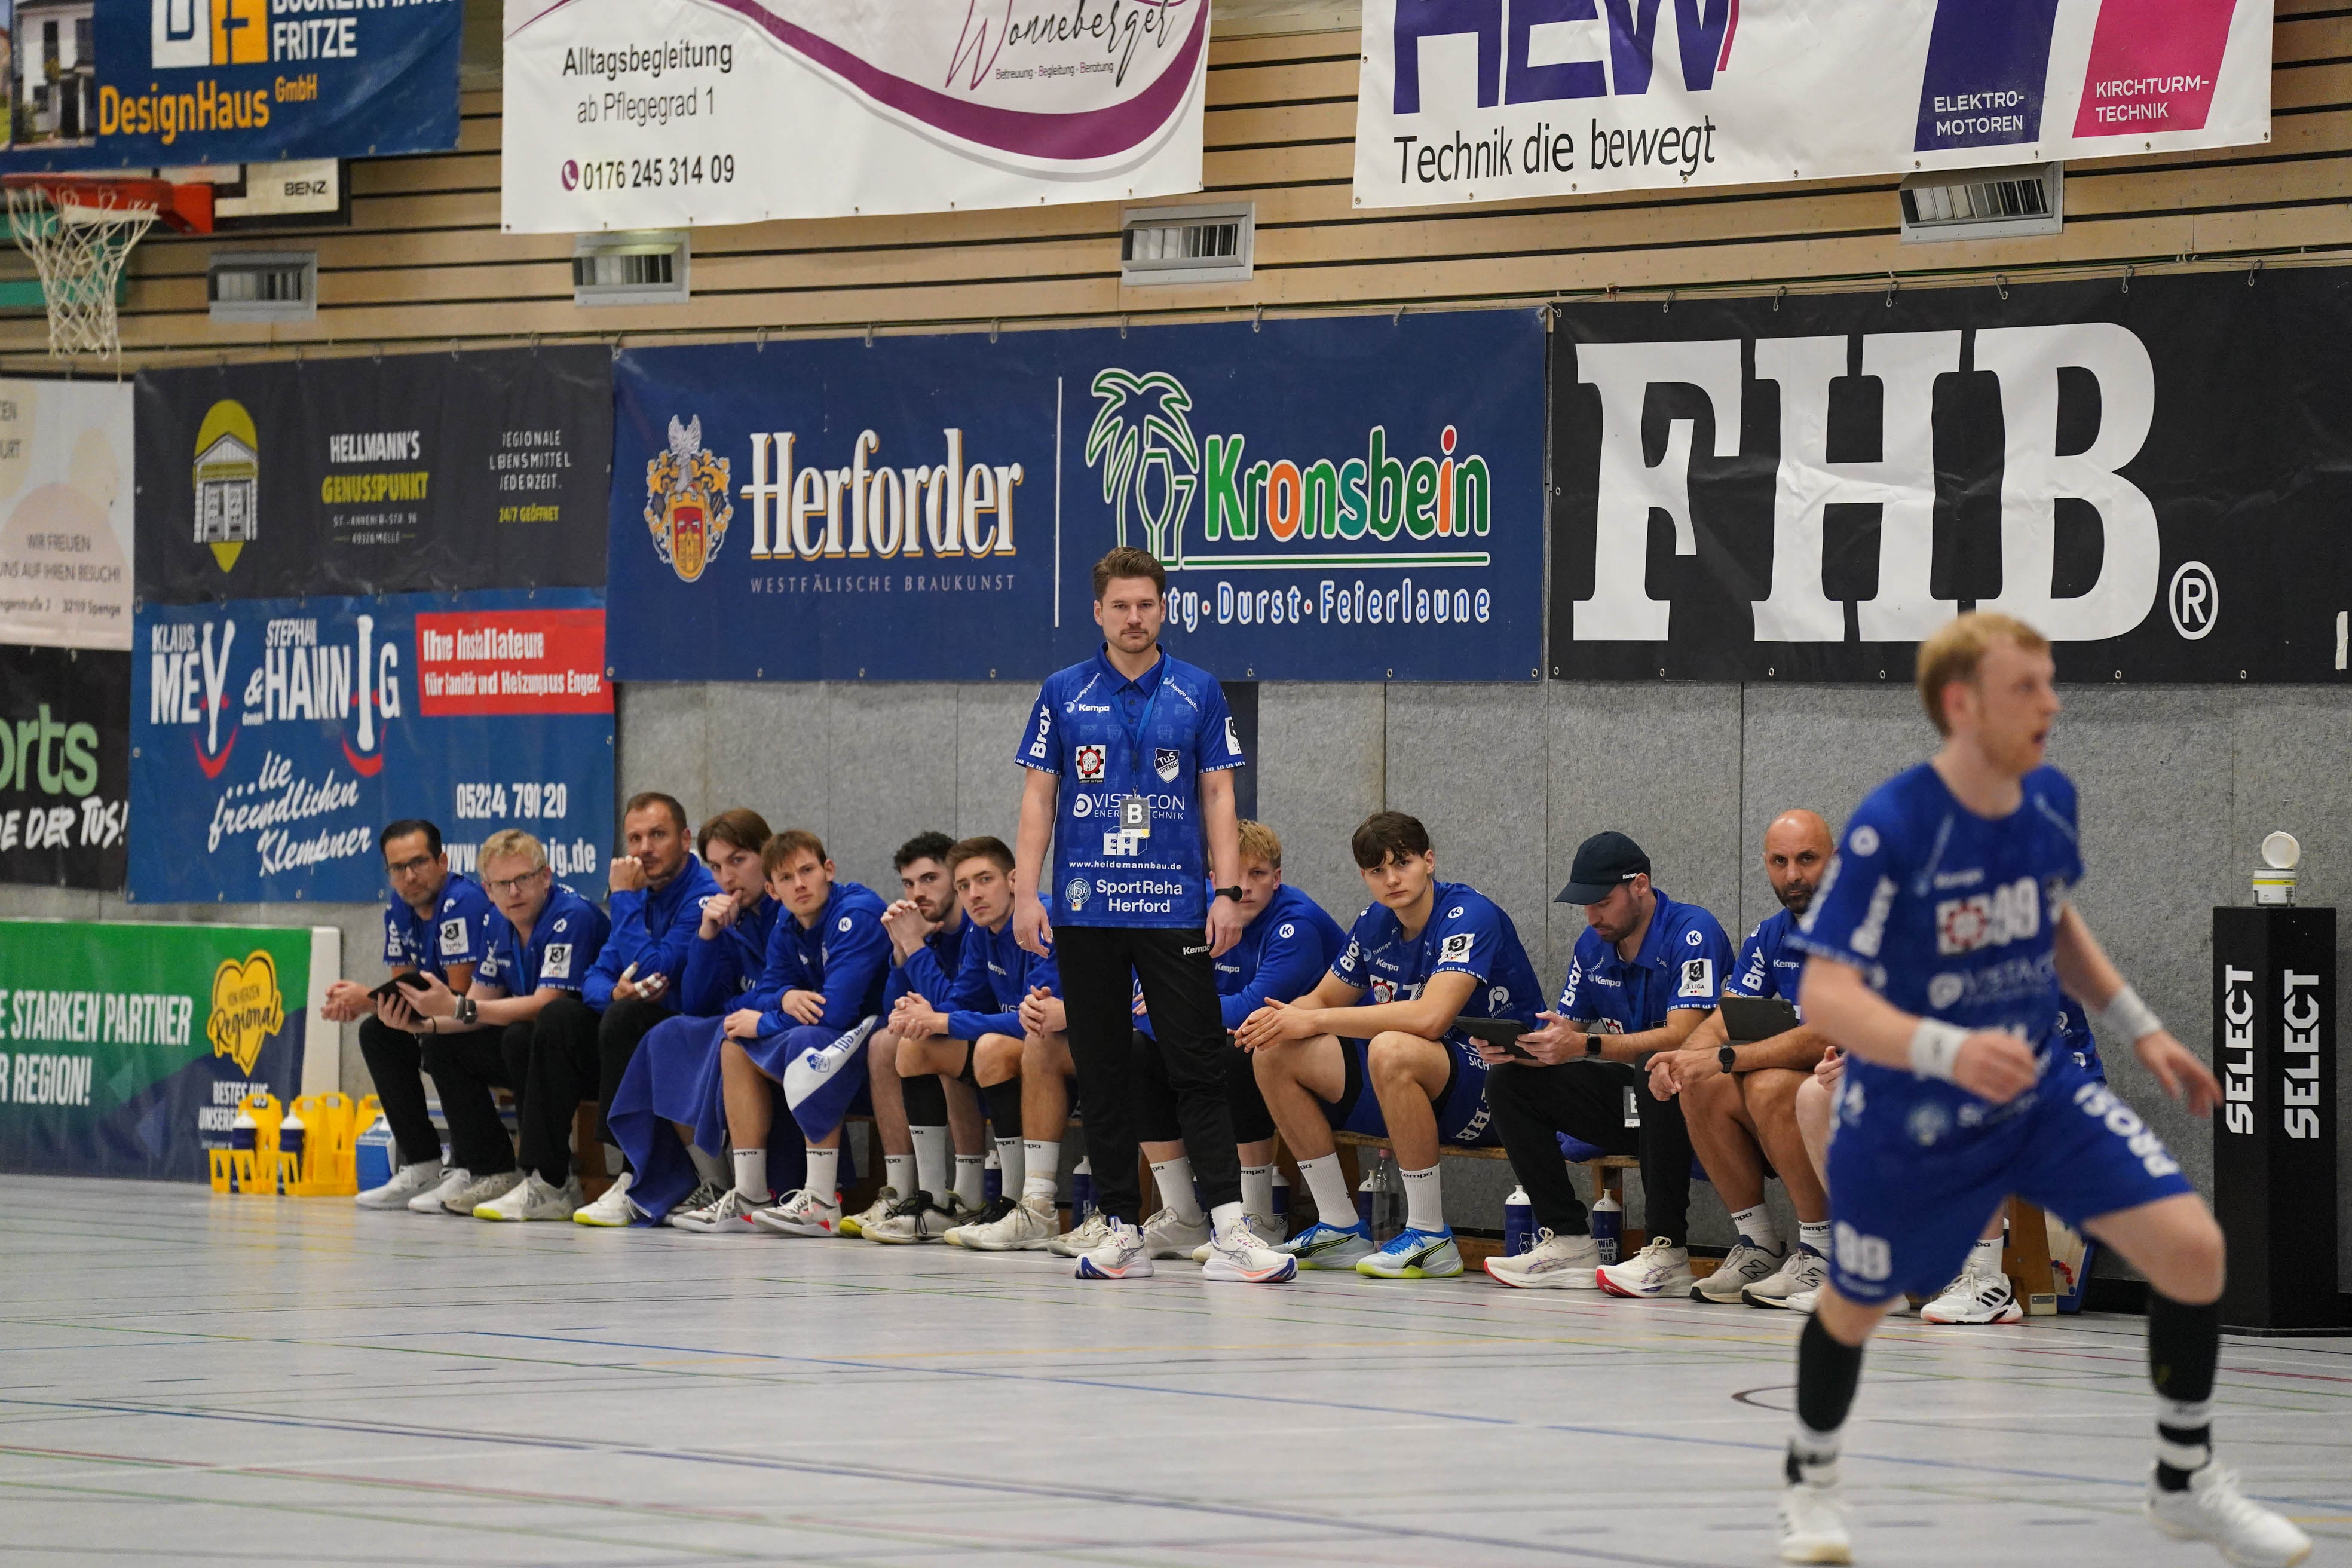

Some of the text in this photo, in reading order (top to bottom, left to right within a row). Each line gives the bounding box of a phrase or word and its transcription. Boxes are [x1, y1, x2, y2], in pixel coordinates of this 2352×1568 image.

[274, 17, 358, 62] FRITZE
[562, 41, 733, 81] Alltagsbegleitung
[1934, 91, 2025, 113] ELEKTRO-
[2095, 75, 2209, 99] KIRCHTURM-
[99, 74, 318, 145] DesignHaus GmbH
[577, 86, 715, 127] ab Pflegegrad 1
[2095, 102, 2169, 124] TECHNIK
[1936, 114, 2023, 137] MOTOREN
[1394, 115, 1716, 184] Technik die bewegt
[284, 180, 327, 196] BENZ
[583, 154, 735, 191] 0176 245 314 09
[330, 430, 421, 464] HELLMANN'S
[321, 471, 429, 504] GENUSSPUNKT
[739, 427, 1024, 562] Herforder
[1205, 424, 1491, 542] Kronsbein
[1573, 322, 2160, 641] FHB
[750, 572, 1015, 594] WESTFÄLISCHE BRAUKUNST
[1217, 581, 1301, 625] Durst
[1319, 577, 1490, 624] Feierlaune
[152, 623, 196, 653] KLAUS
[422, 627, 545, 662] Ihre Installateure
[151, 619, 236, 755] MEY
[244, 667, 264, 707] &
[424, 670, 443, 697] für
[1078, 703, 1110, 713] Kempa
[1029, 703, 1051, 759] Brax
[1157, 751, 1177, 767] TuS
[1158, 760, 1180, 775] SPENGE
[1092, 793, 1185, 811] VISCON
[1094, 810, 1184, 820] ENERCHNIK
[1127, 803, 1143, 824] B
[25, 807, 76, 850] DER
[1069, 860, 1182, 870] www.heidemannbau.de
[1108, 898, 1171, 914] Herford
[1372, 941, 1392, 955] hapego
[1595, 975, 1621, 988] Kempa
[11, 989, 101, 1043] STARKEN
[103, 993, 194, 1046] PARTNER
[2225, 964, 2254, 1135] SELECT
[2284, 969, 2320, 1139] SELECT
[12, 1053, 93, 1107] REGION!
